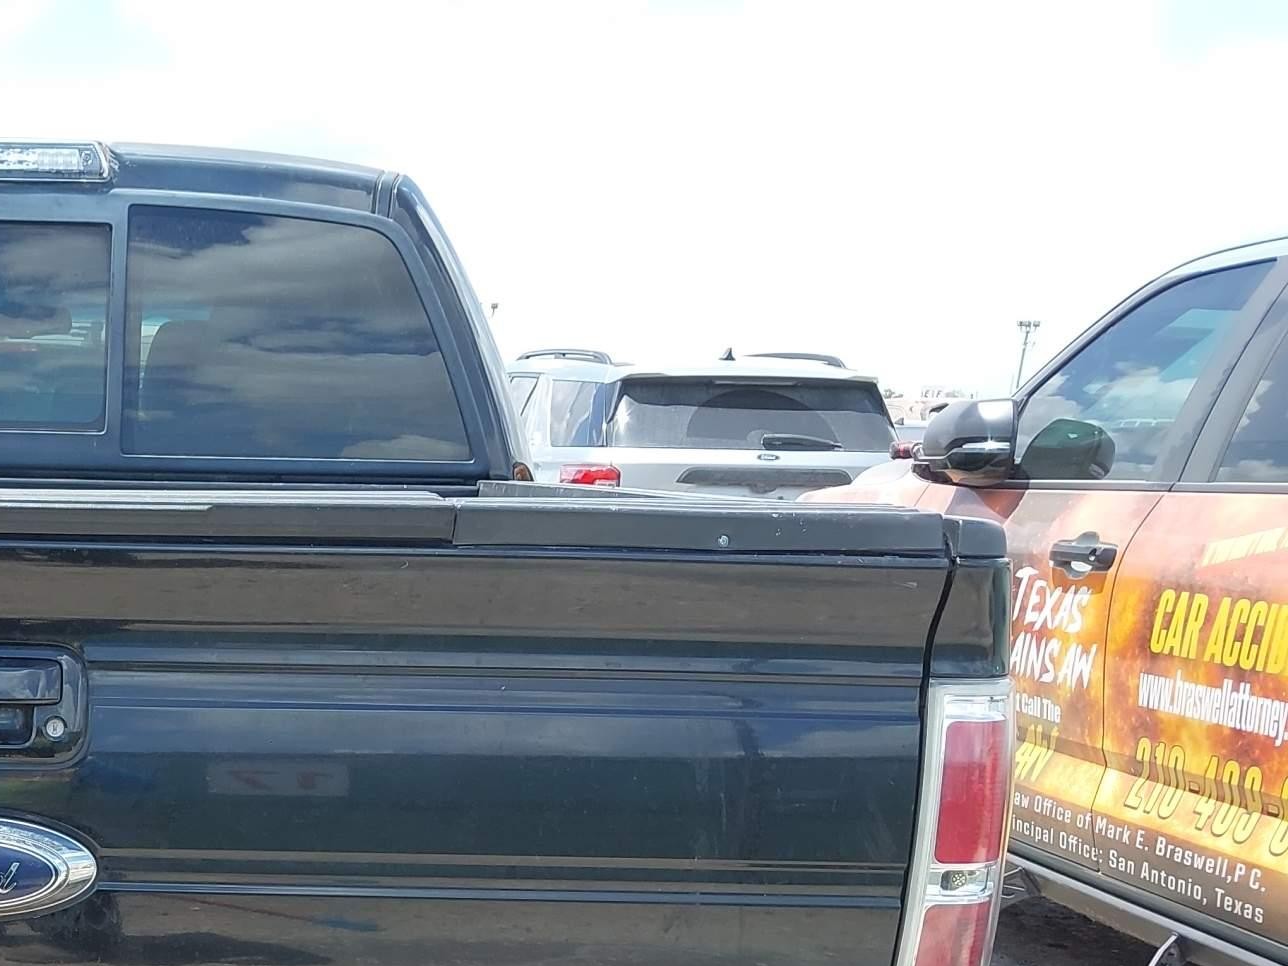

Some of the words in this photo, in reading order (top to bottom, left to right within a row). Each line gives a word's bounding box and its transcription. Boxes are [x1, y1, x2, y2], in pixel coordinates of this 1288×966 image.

[1013, 566, 1092, 633] TEXAS
[1150, 588, 1209, 660] CAR
[1203, 597, 1288, 676] ACCID
[1010, 630, 1098, 691] AINSAW
[1021, 693, 1041, 718] Call
[1042, 697, 1061, 723] The
[1138, 669, 1288, 747] www.braswellattorney.
[1014, 791, 1030, 809] aw
[1034, 795, 1072, 823] Office
[1076, 812, 1093, 830] of
[1095, 816, 1131, 845] Mark
[1135, 829, 1149, 851] E.
[1012, 814, 1054, 845] incipal
[1059, 831, 1103, 863] Office:
[1109, 849, 1135, 875] San
[1140, 861, 1208, 906] Antonio,
[1214, 887, 1264, 924] Texas
